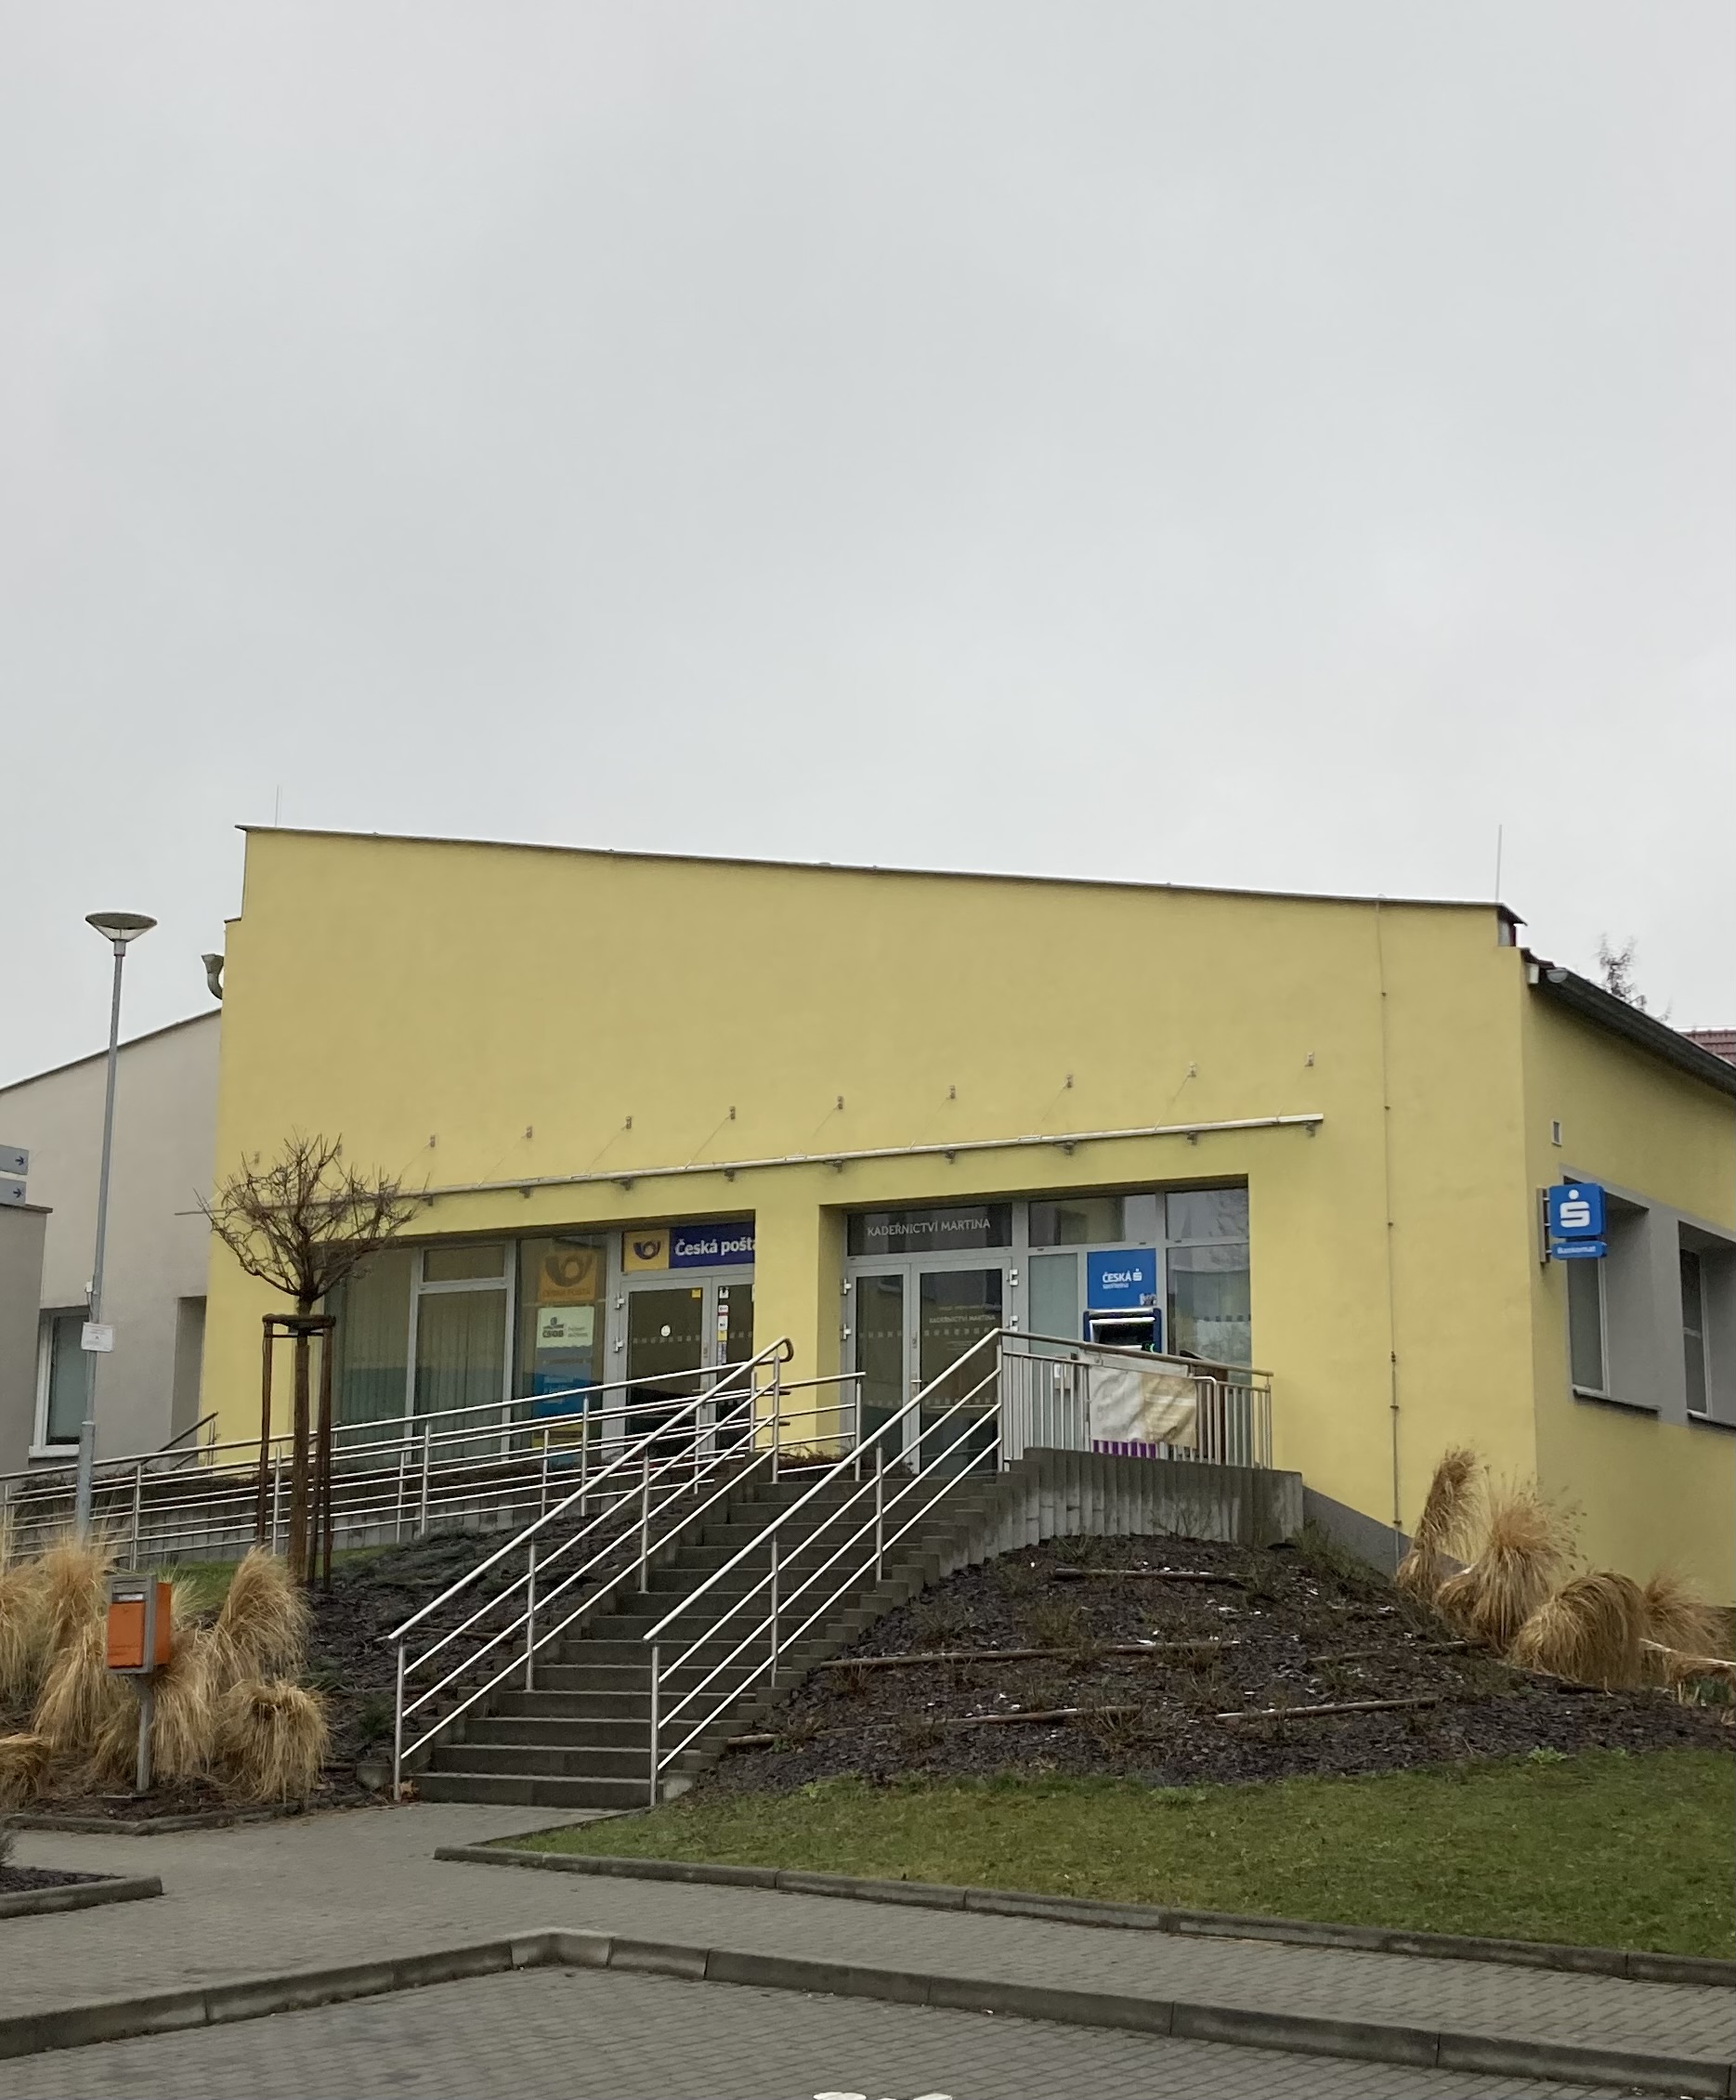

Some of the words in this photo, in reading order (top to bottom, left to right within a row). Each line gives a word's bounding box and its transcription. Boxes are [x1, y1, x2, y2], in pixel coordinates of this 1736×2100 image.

[941, 1218, 991, 1232] MARTINA
[675, 1238, 717, 1256] Česká
[1103, 1271, 1131, 1283] ČESKÁ
